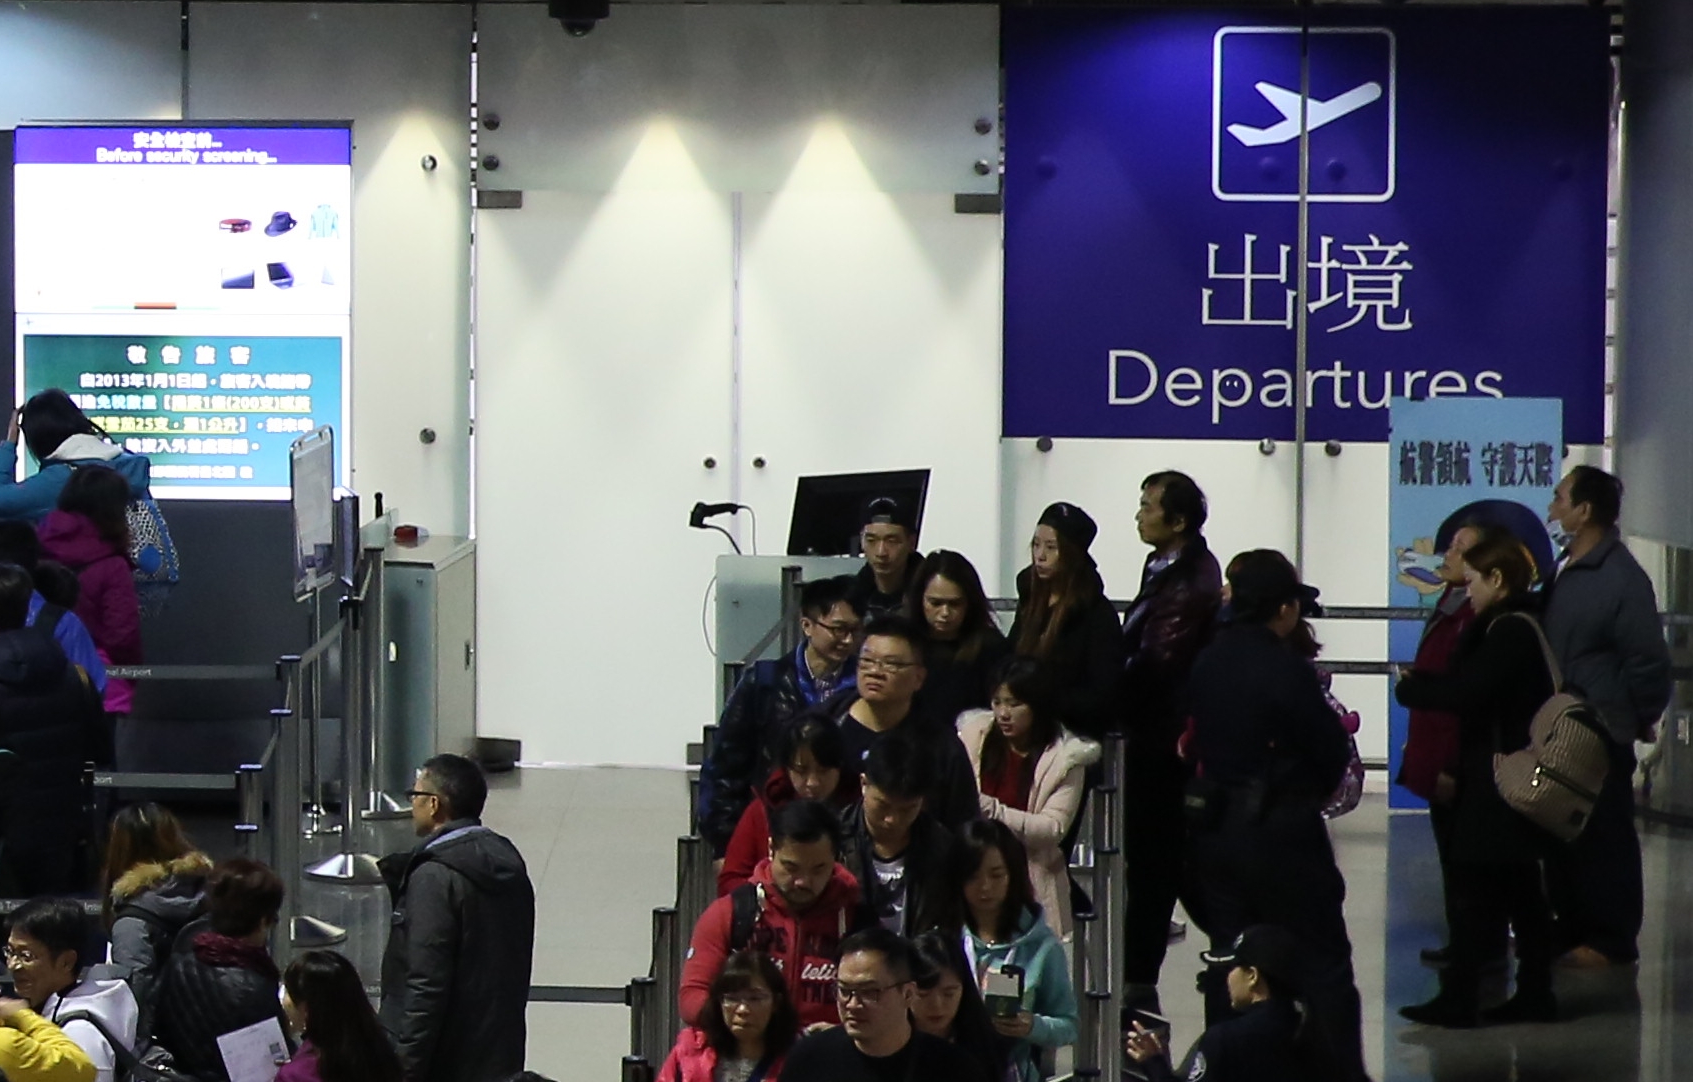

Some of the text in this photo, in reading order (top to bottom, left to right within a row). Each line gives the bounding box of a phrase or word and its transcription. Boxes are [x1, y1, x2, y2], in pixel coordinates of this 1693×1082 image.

[96, 147, 143, 163] Before
[146, 147, 199, 165] security
[1201, 233, 1414, 333] 出境
[1108, 349, 1504, 424] Departures
